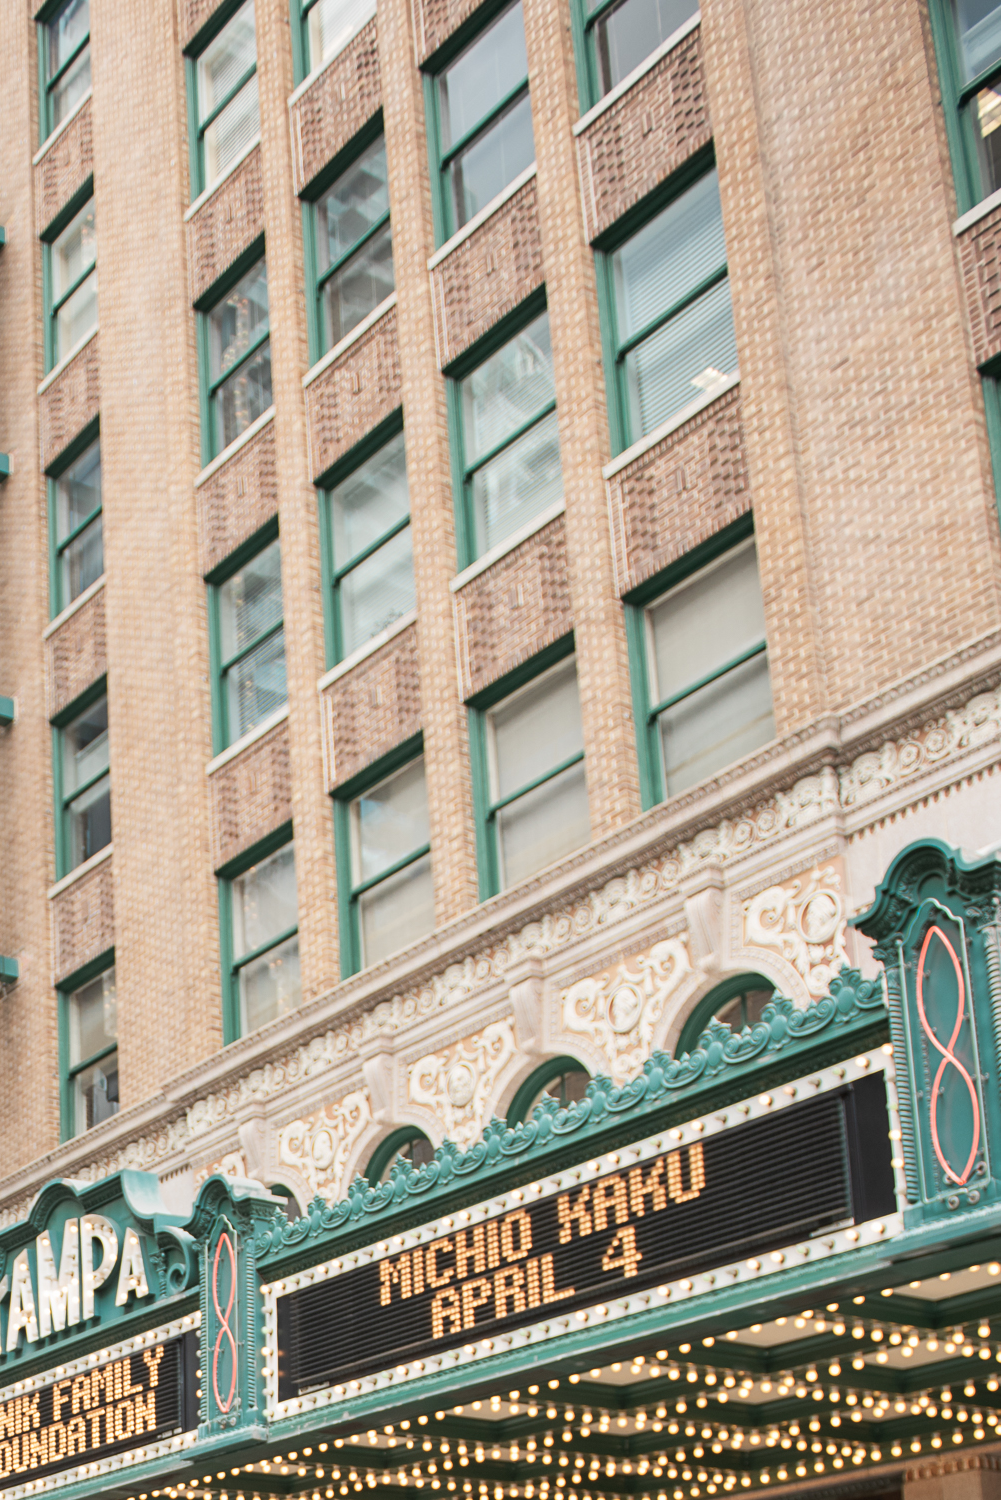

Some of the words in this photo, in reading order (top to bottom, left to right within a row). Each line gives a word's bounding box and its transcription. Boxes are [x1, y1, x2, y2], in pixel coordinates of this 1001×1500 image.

[379, 1209, 533, 1307] MICHIO
[557, 1142, 707, 1244] KAKU
[431, 1252, 576, 1339] APRIL
[602, 1225, 643, 1279] 4
[52, 1344, 165, 1422] FAMILY
